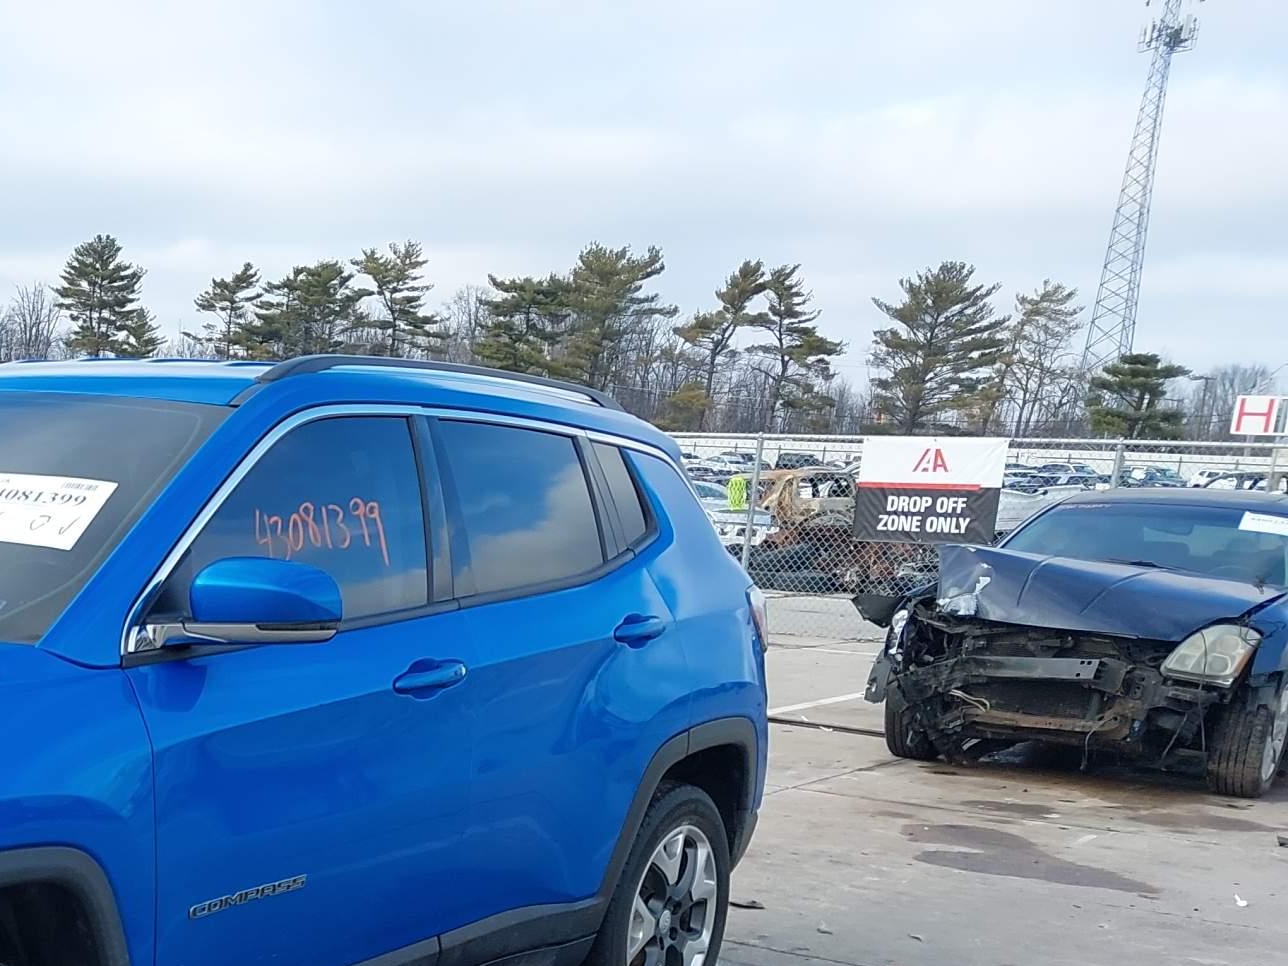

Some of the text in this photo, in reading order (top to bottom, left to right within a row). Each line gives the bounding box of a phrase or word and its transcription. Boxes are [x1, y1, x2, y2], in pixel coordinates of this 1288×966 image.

[1235, 398, 1274, 433] H
[886, 495, 967, 514] DROP OFF
[876, 514, 970, 534] ZONE ONLY
[189, 874, 308, 919] COMPASS
